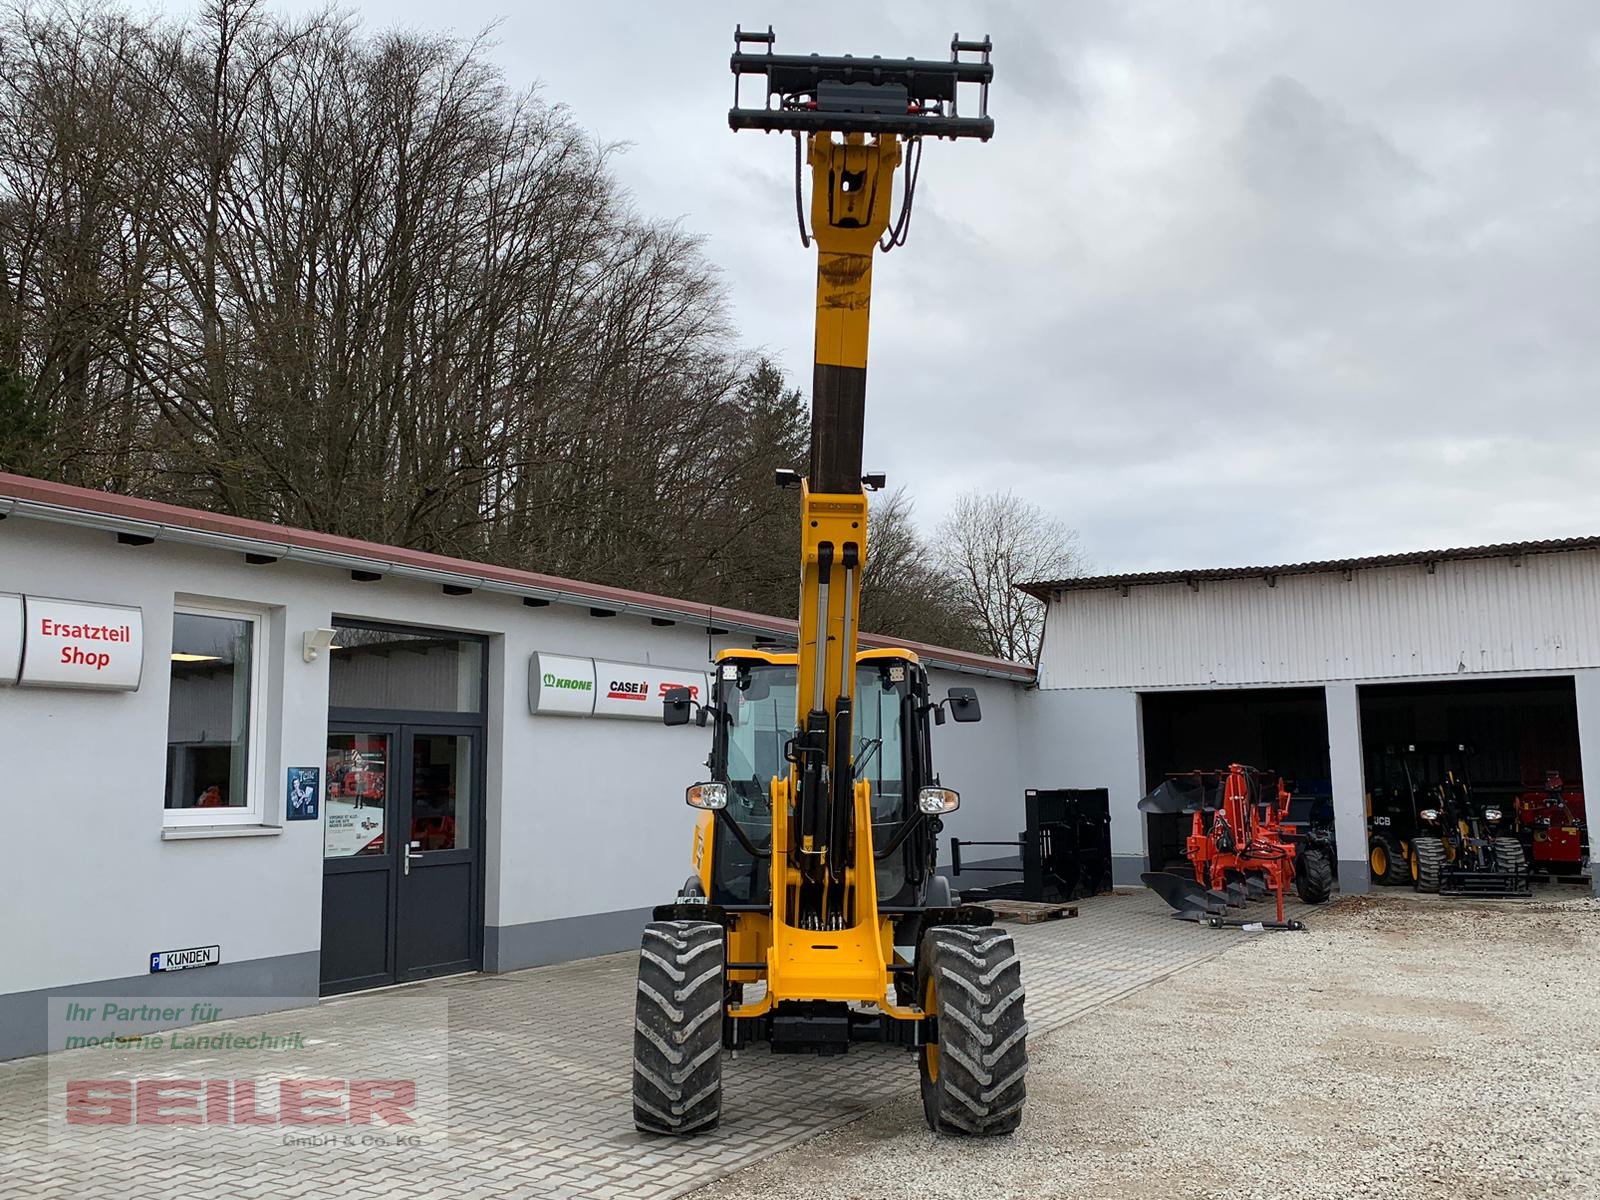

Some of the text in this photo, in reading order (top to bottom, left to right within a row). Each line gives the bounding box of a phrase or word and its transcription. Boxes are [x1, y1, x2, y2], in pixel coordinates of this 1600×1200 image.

[42, 619, 129, 642] Ersatzteil
[61, 647, 110, 670] Shop
[556, 679, 592, 690] KRONE
[610, 681, 638, 693] CASE
[1374, 816, 1391, 826] JCB
[152, 957, 160, 967] P
[166, 949, 210, 966] KUNDEN
